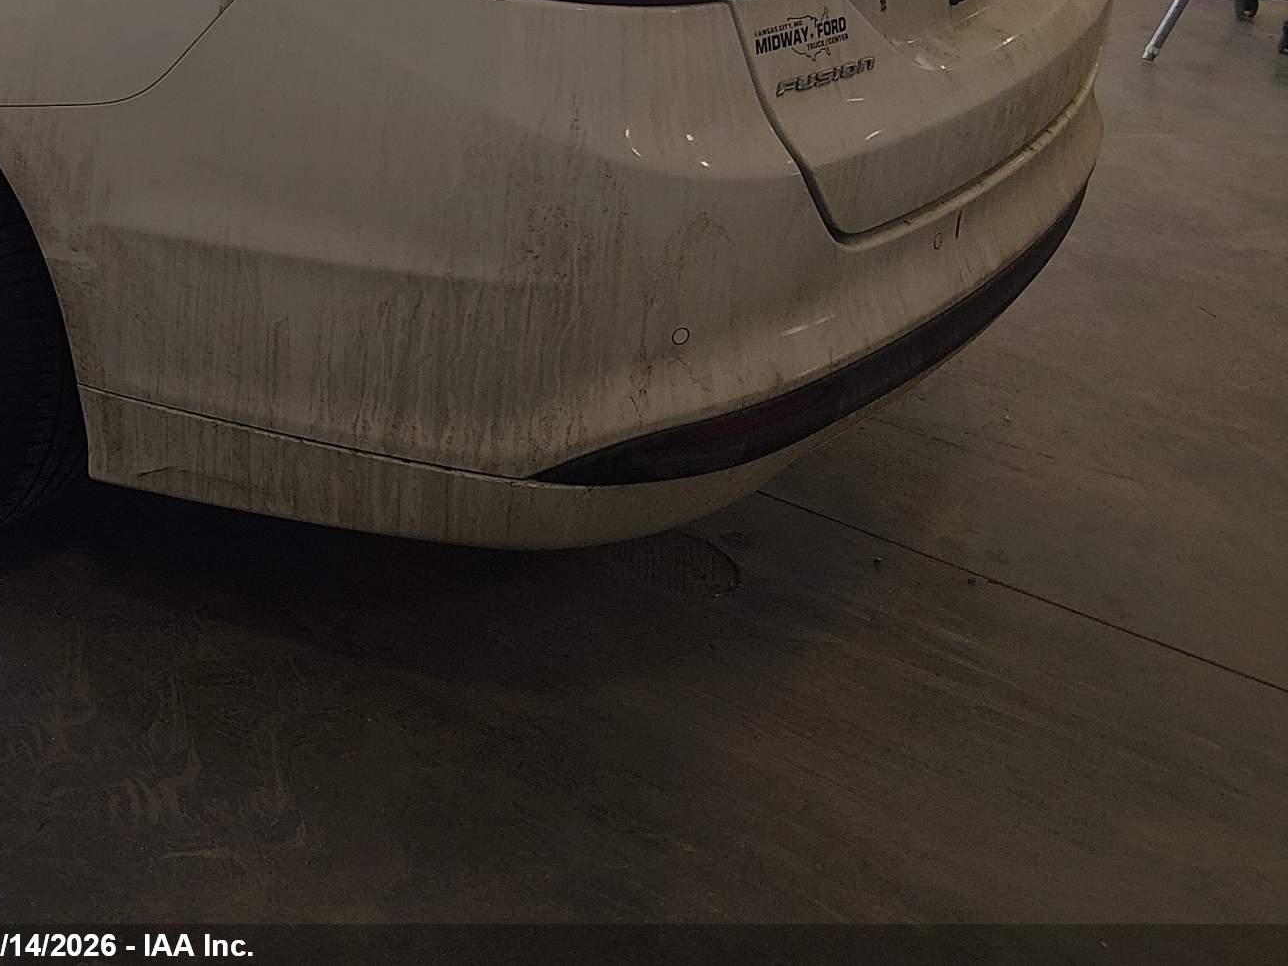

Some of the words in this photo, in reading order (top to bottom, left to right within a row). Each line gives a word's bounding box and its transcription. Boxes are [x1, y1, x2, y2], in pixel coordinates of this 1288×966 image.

[755, 26, 809, 55] MIDWAY
[817, 16, 847, 38] FORD
[807, 40, 825, 51] TRUCK
[828, 33, 849, 46] CENTER
